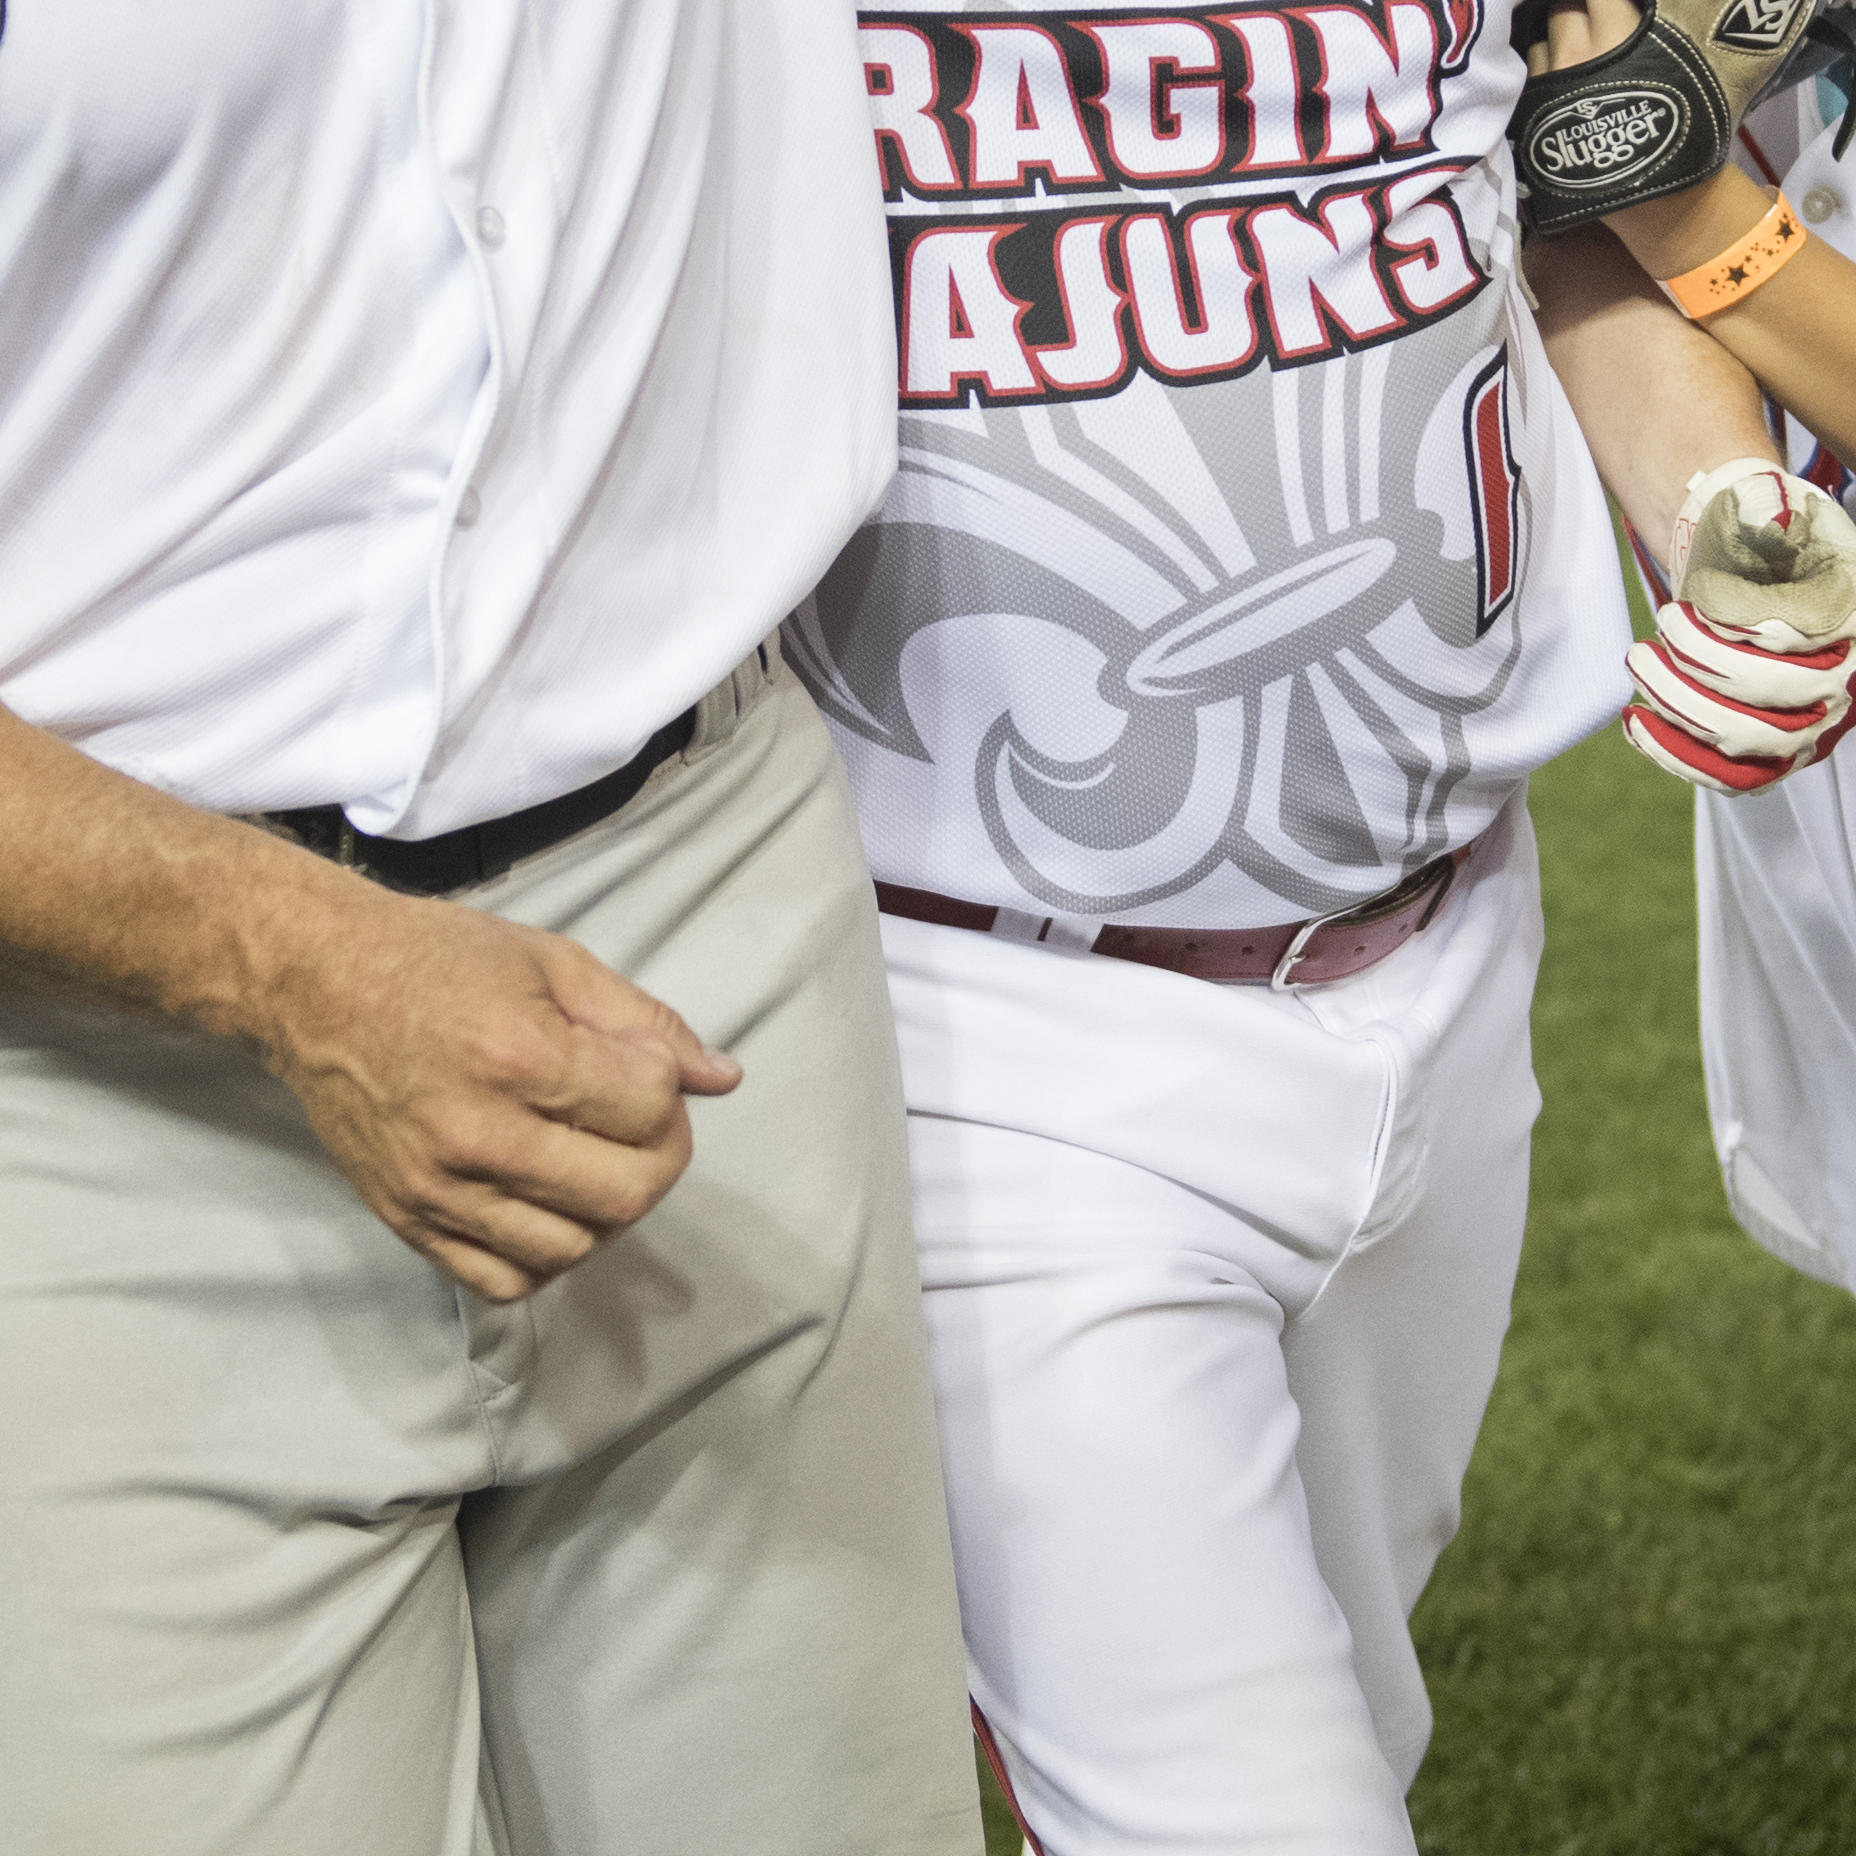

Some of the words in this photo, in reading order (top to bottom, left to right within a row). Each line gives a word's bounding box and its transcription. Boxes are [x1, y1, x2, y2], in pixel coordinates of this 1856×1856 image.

[1541, 109, 1662, 172] Slugger
[1561, 99, 1653, 142] LOUISVILLE
[886, 156, 1494, 410] AJUNS
